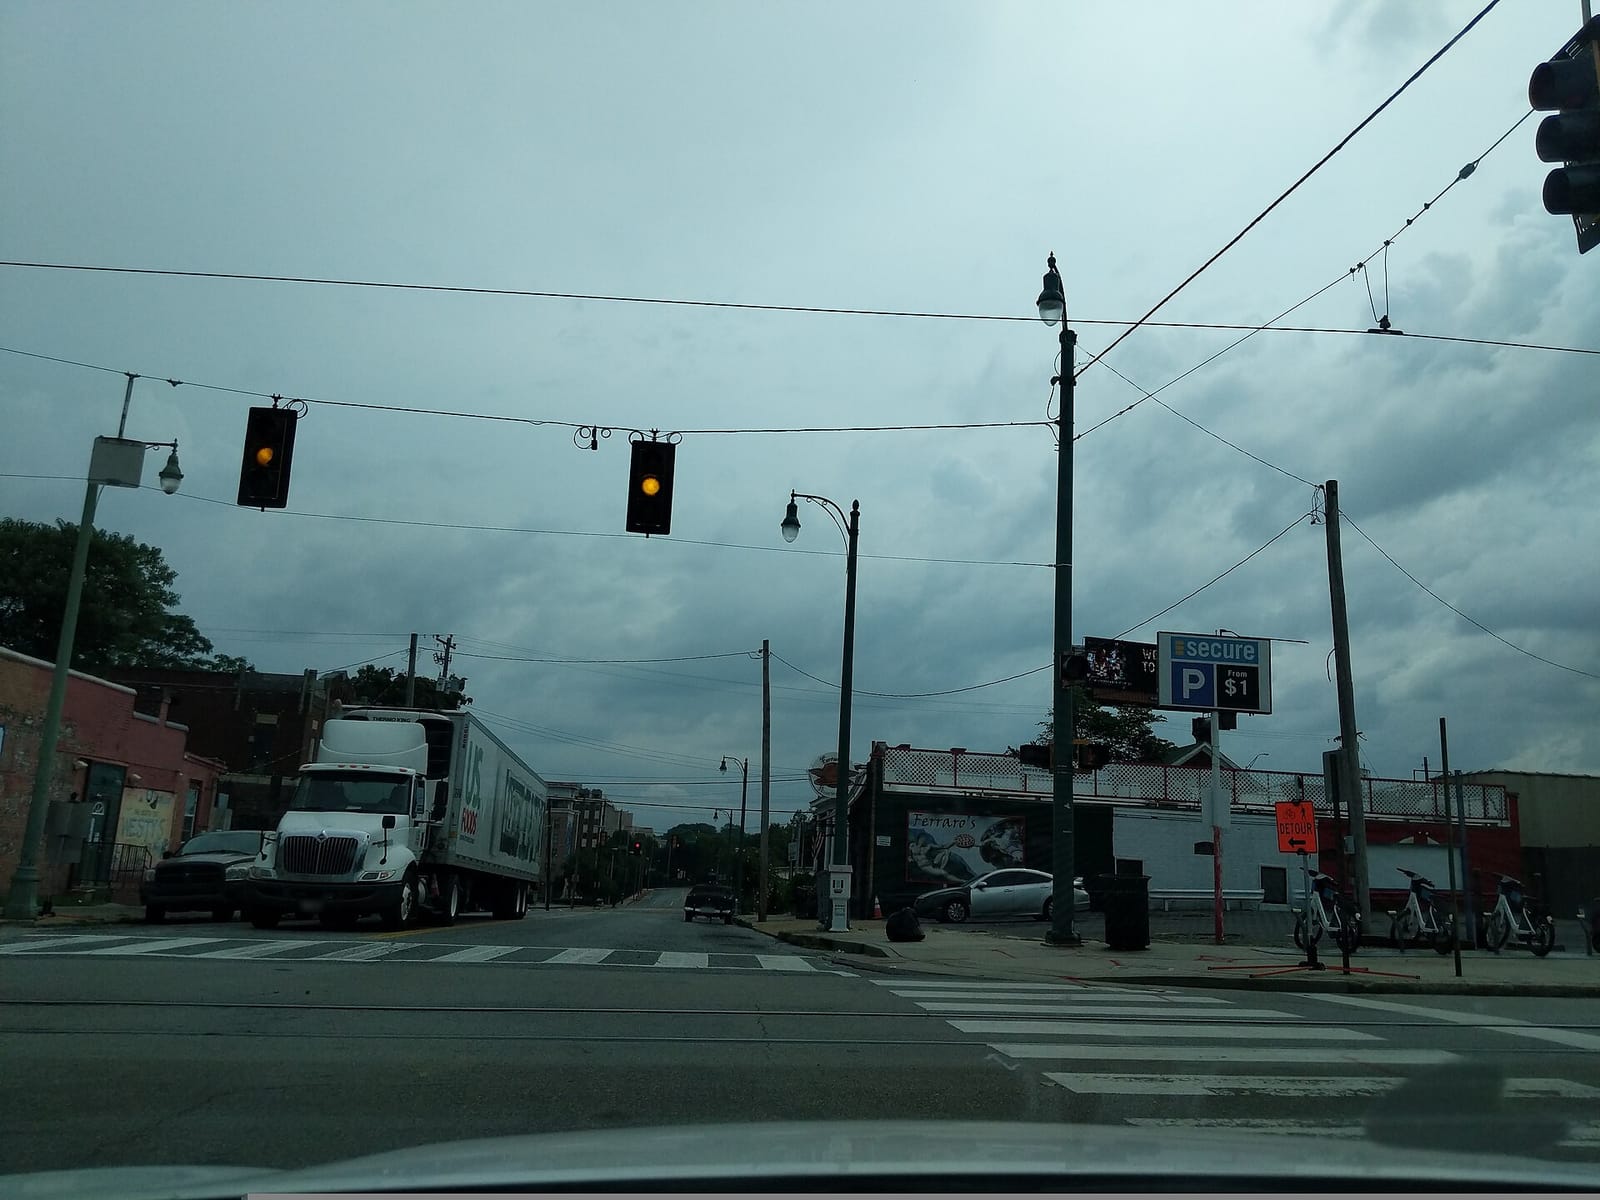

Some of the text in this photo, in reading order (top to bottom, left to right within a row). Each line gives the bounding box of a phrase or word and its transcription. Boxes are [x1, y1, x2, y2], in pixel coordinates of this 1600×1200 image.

[1187, 639, 1255, 661] secure
[1228, 669, 1248, 679] From
[1182, 668, 1206, 699] P
[1225, 678, 1248, 697] $1
[912, 813, 977, 829] Ferraro's
[1280, 822, 1313, 835] DETOUR
